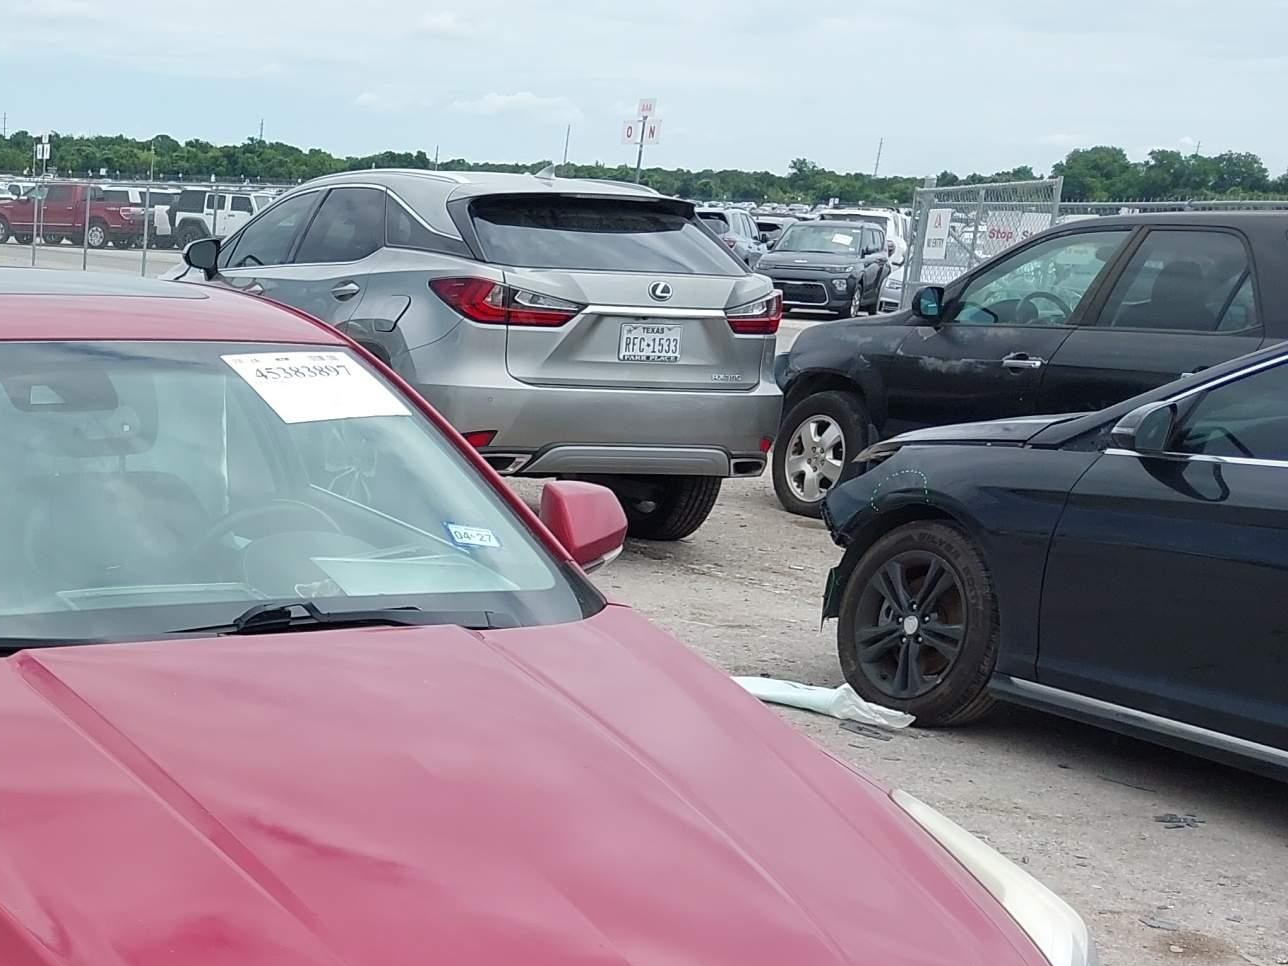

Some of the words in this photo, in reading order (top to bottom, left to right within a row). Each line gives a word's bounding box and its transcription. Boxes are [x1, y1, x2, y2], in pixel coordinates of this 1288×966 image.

[648, 126, 656, 138] N
[988, 228, 1013, 241] Stop
[642, 327, 665, 335] TEXAS
[256, 365, 351, 380] 45383897
